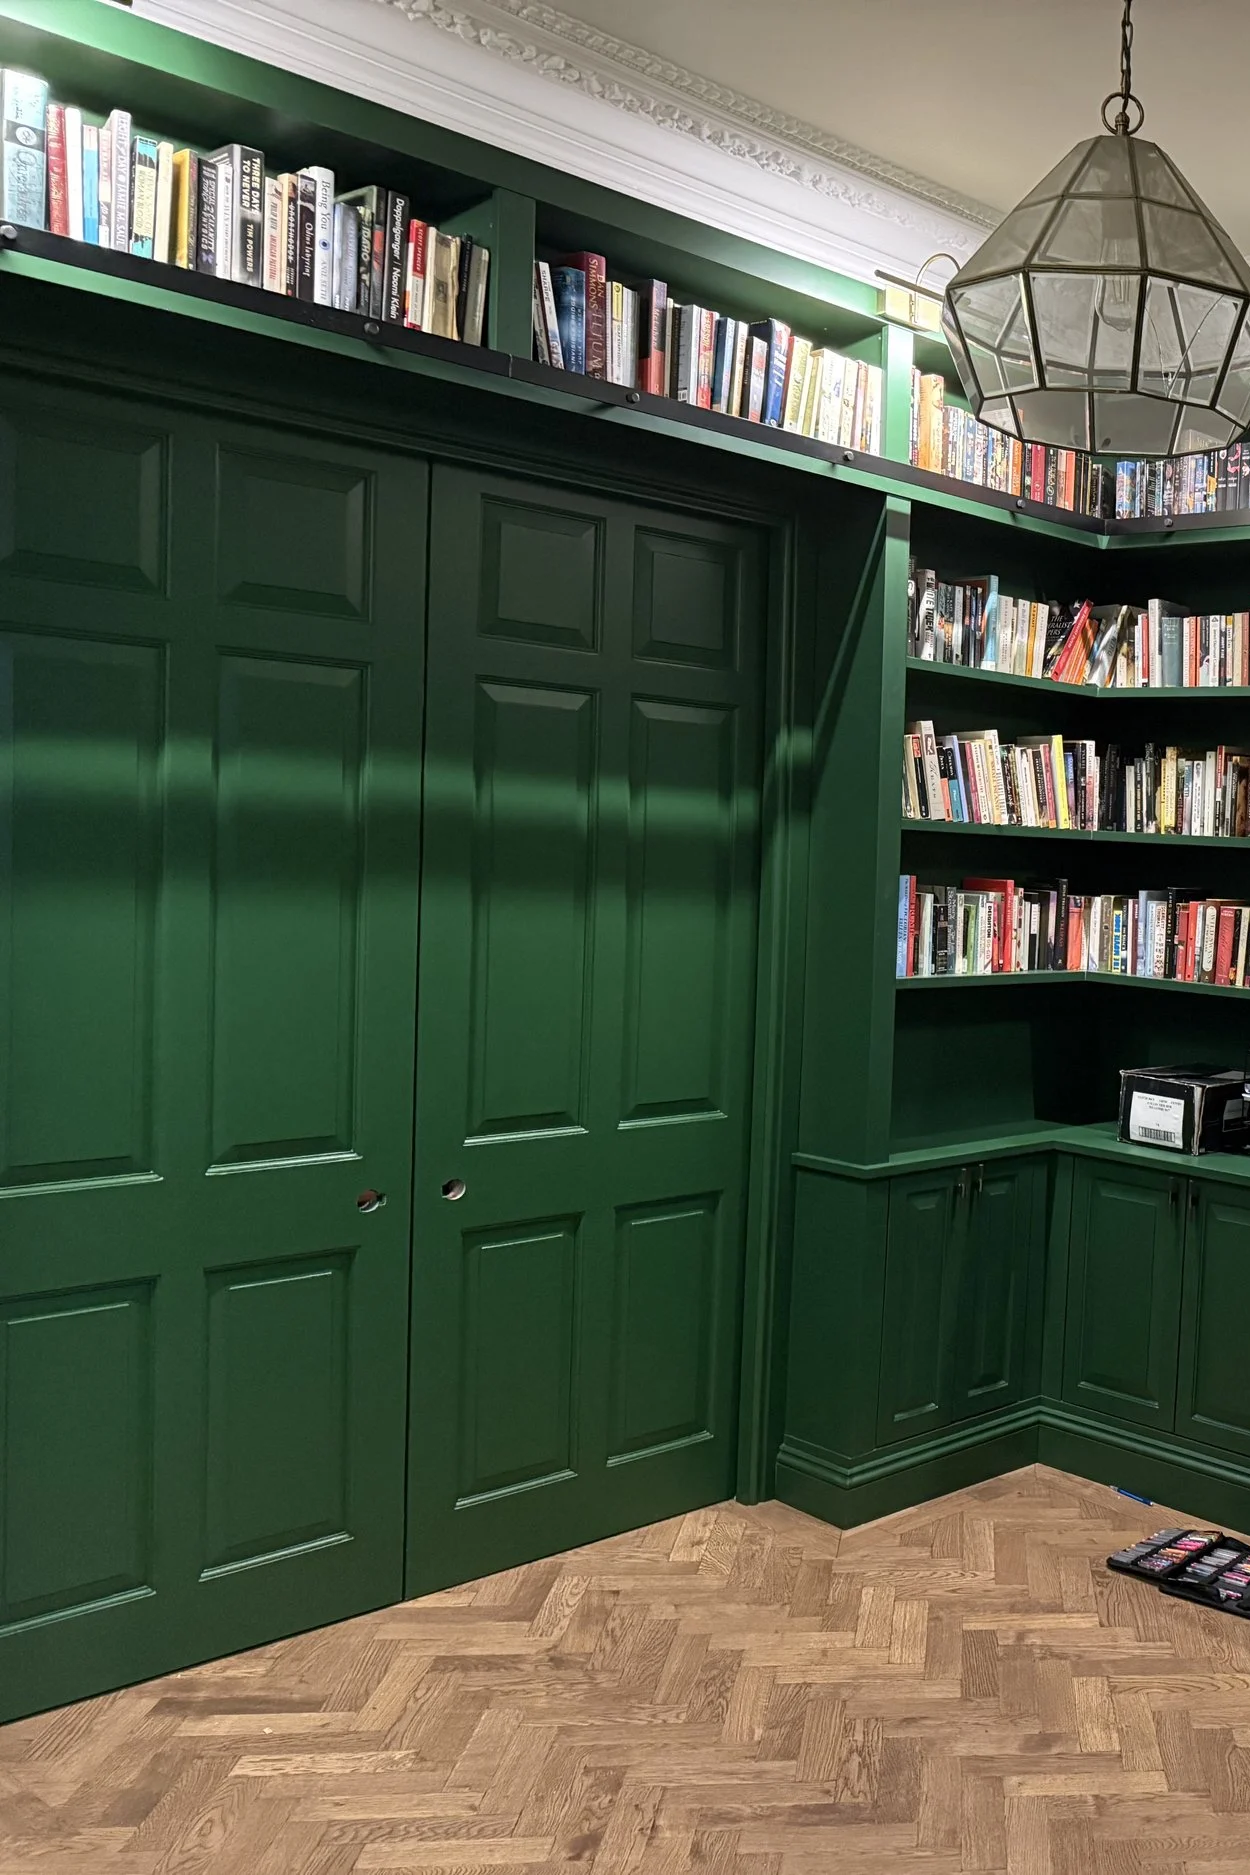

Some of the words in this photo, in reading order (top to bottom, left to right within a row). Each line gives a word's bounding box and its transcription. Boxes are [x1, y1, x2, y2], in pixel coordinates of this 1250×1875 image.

[251, 158, 260, 189] THREE
[117, 184, 127, 212] JAMIE
[251, 191, 260, 214] DAYS
[318, 180, 330, 209] Being
[116, 224, 126, 246] SAUL
[321, 212, 330, 230] You
[391, 198, 404, 260] Doppelganger
[361, 226, 370, 262] IDAHO
[415, 247, 424, 271] SPENCER
[541, 270, 550, 302] SHARPE
[589, 258, 599, 310] SIMMONS
[390, 298, 399, 318] Klein
[591, 313, 604, 368] ILIUM
[925, 608, 934, 632] TIGER
[1206, 939, 1215, 964] SWANS
